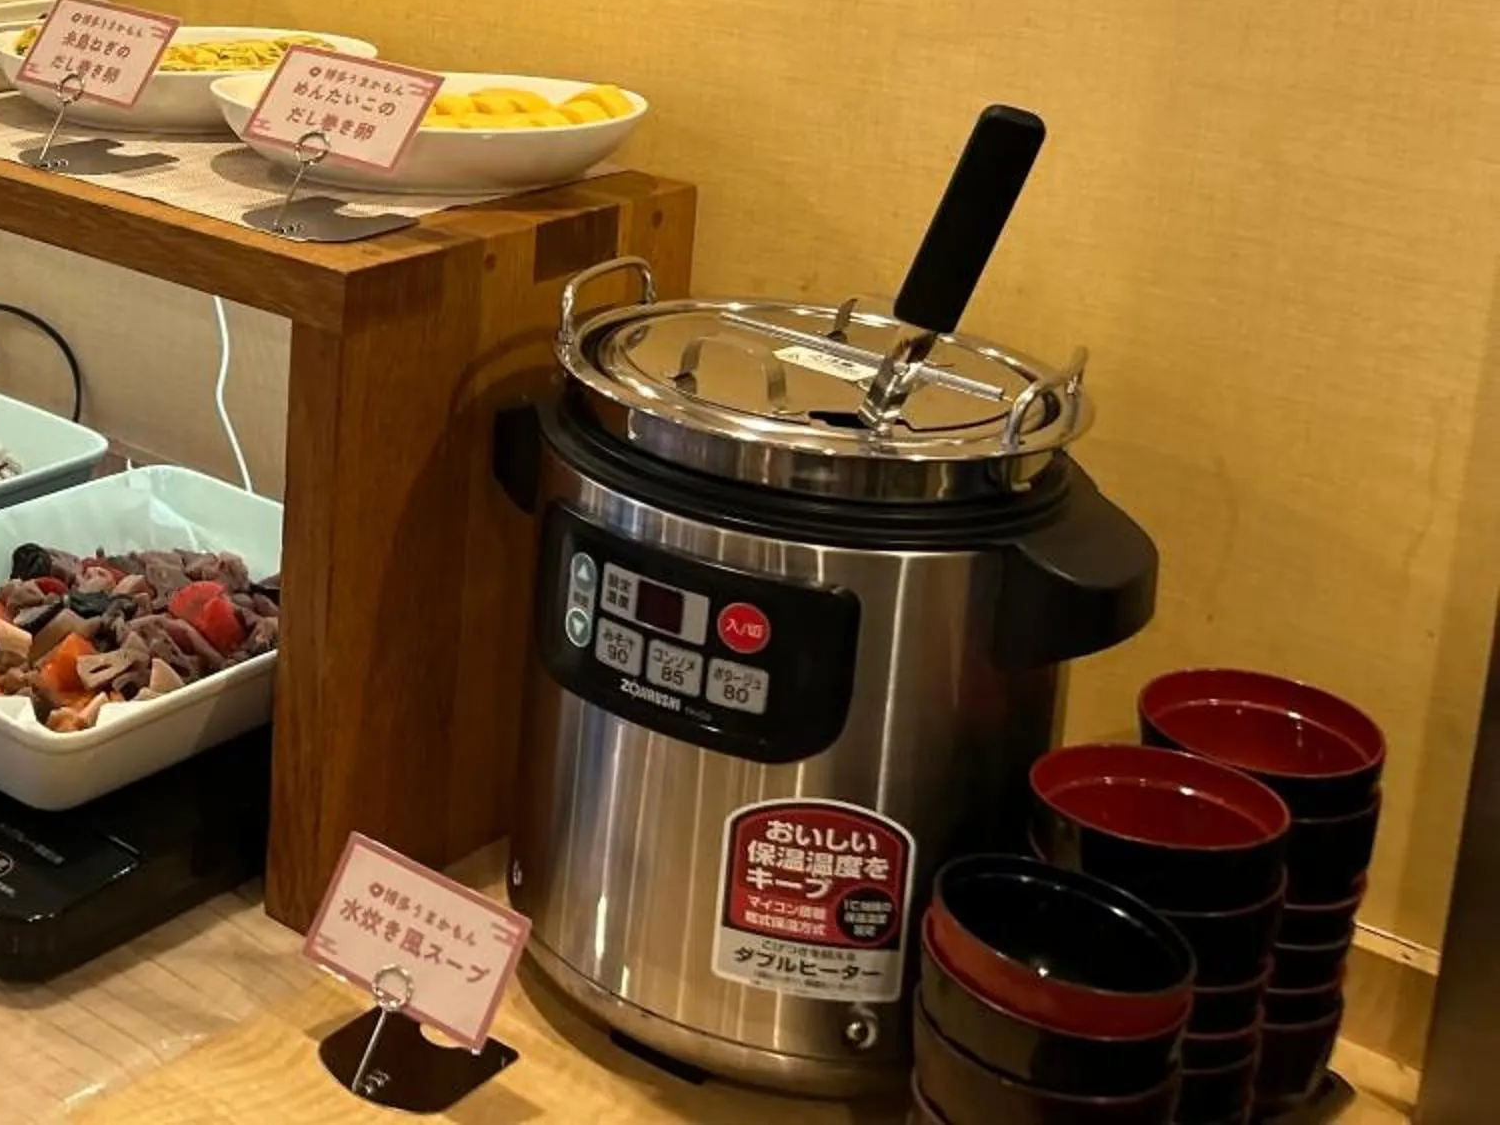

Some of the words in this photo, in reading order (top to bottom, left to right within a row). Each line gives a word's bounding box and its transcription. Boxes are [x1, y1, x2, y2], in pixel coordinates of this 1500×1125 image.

[51, 55, 122, 84] だし巻き卵
[293, 81, 396, 116] めんたいこの
[286, 107, 377, 141] だし巻き卵
[607, 644, 630, 666] 90
[653, 648, 697, 673] コンソメ
[661, 666, 685, 687] 85
[723, 685, 750, 705] 80
[765, 820, 878, 853] おいしい
[746, 839, 890, 881] 保温温度を
[746, 867, 835, 900] キープ
[340, 898, 491, 984] 水炊き風スープ
[734, 946, 882, 981] ダブルヒーター
